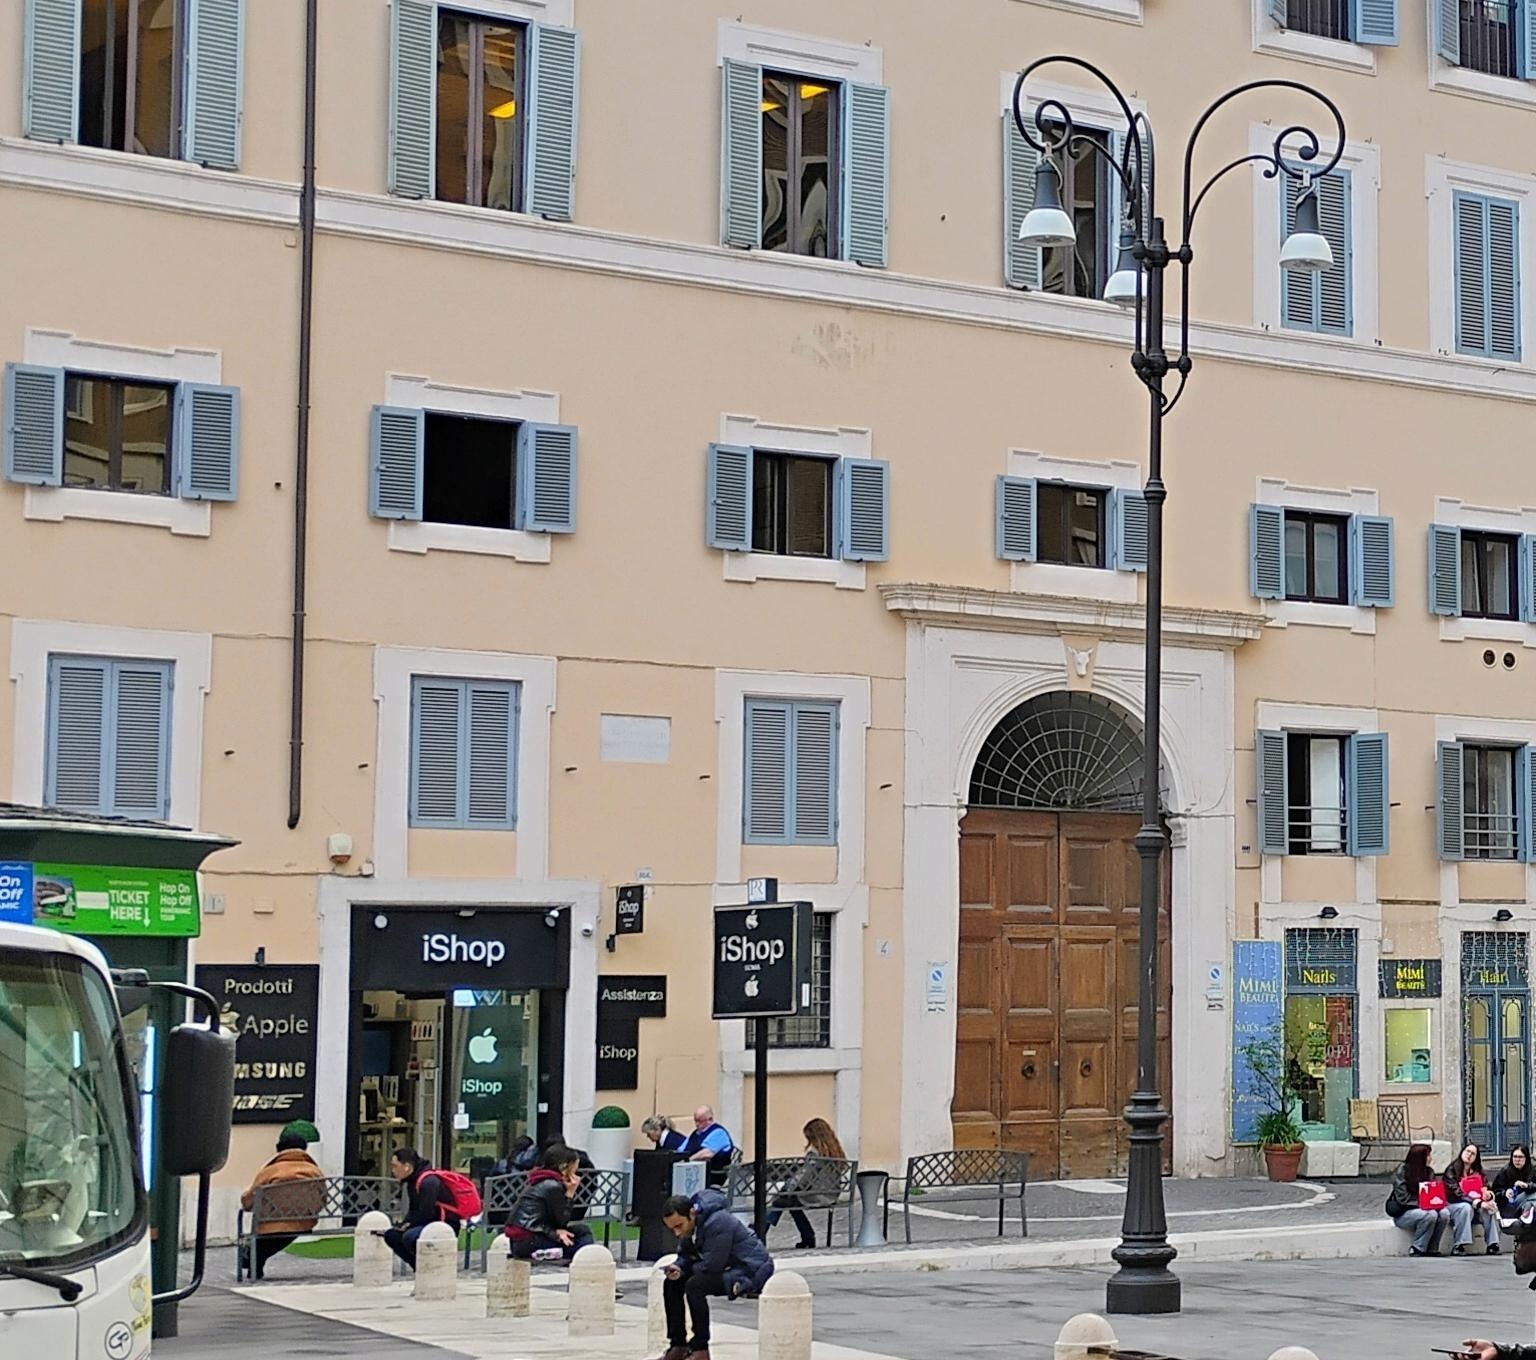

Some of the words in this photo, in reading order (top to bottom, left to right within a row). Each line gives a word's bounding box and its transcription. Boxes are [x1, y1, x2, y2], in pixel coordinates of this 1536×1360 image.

[109, 890, 150, 905] TICKET
[110, 907, 142, 921] HERE
[618, 900, 639, 916] iShop
[422, 933, 505, 967] iShop
[720, 936, 784, 965] iShop
[1302, 969, 1337, 985] Nails
[1478, 969, 1506, 984] Hair
[224, 978, 293, 994] Prodotti
[601, 988, 664, 1001] Assistenza
[243, 1014, 309, 1039] Apple
[600, 1045, 637, 1061] iShop
[233, 1061, 306, 1079] MSUNG
[462, 1079, 502, 1095] iShop
